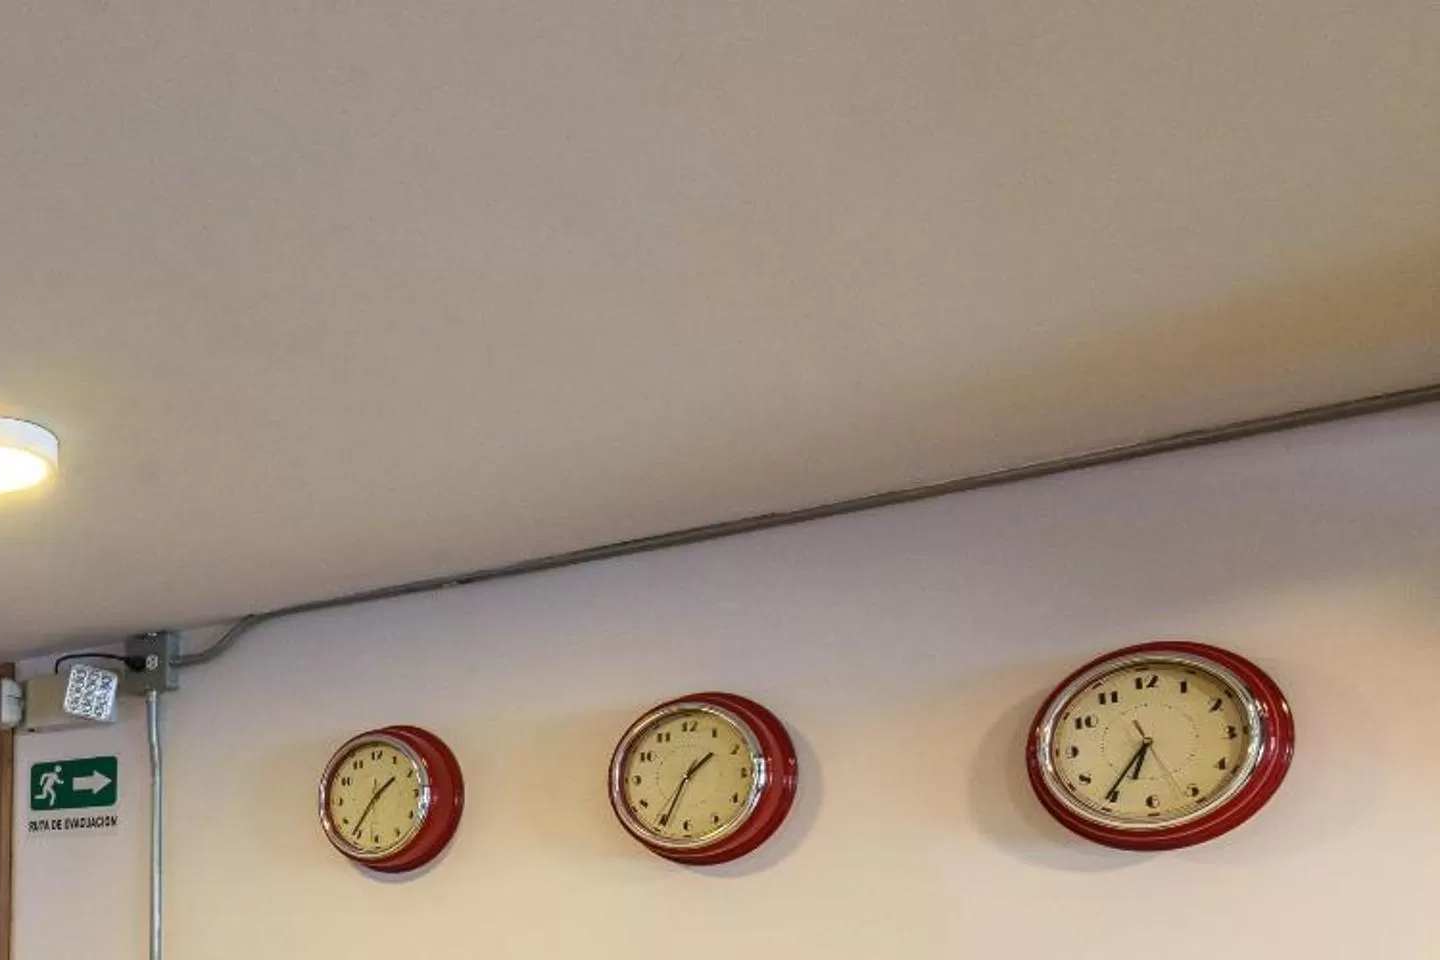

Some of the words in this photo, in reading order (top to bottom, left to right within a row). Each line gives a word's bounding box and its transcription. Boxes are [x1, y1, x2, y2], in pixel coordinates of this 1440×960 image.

[1135, 675, 1159, 690] 12
[1180, 681, 1187, 693] 1
[1098, 690, 1118, 705] 11
[682, 721, 698, 732] 12
[1075, 715, 1098, 730] 10
[657, 732, 671, 743] 11
[712, 728, 717, 738] 1
[371, 750, 383, 760] 12
[641, 750, 656, 762] 10
[353, 760, 363, 770] 11
[51, 819, 62, 830] DE
